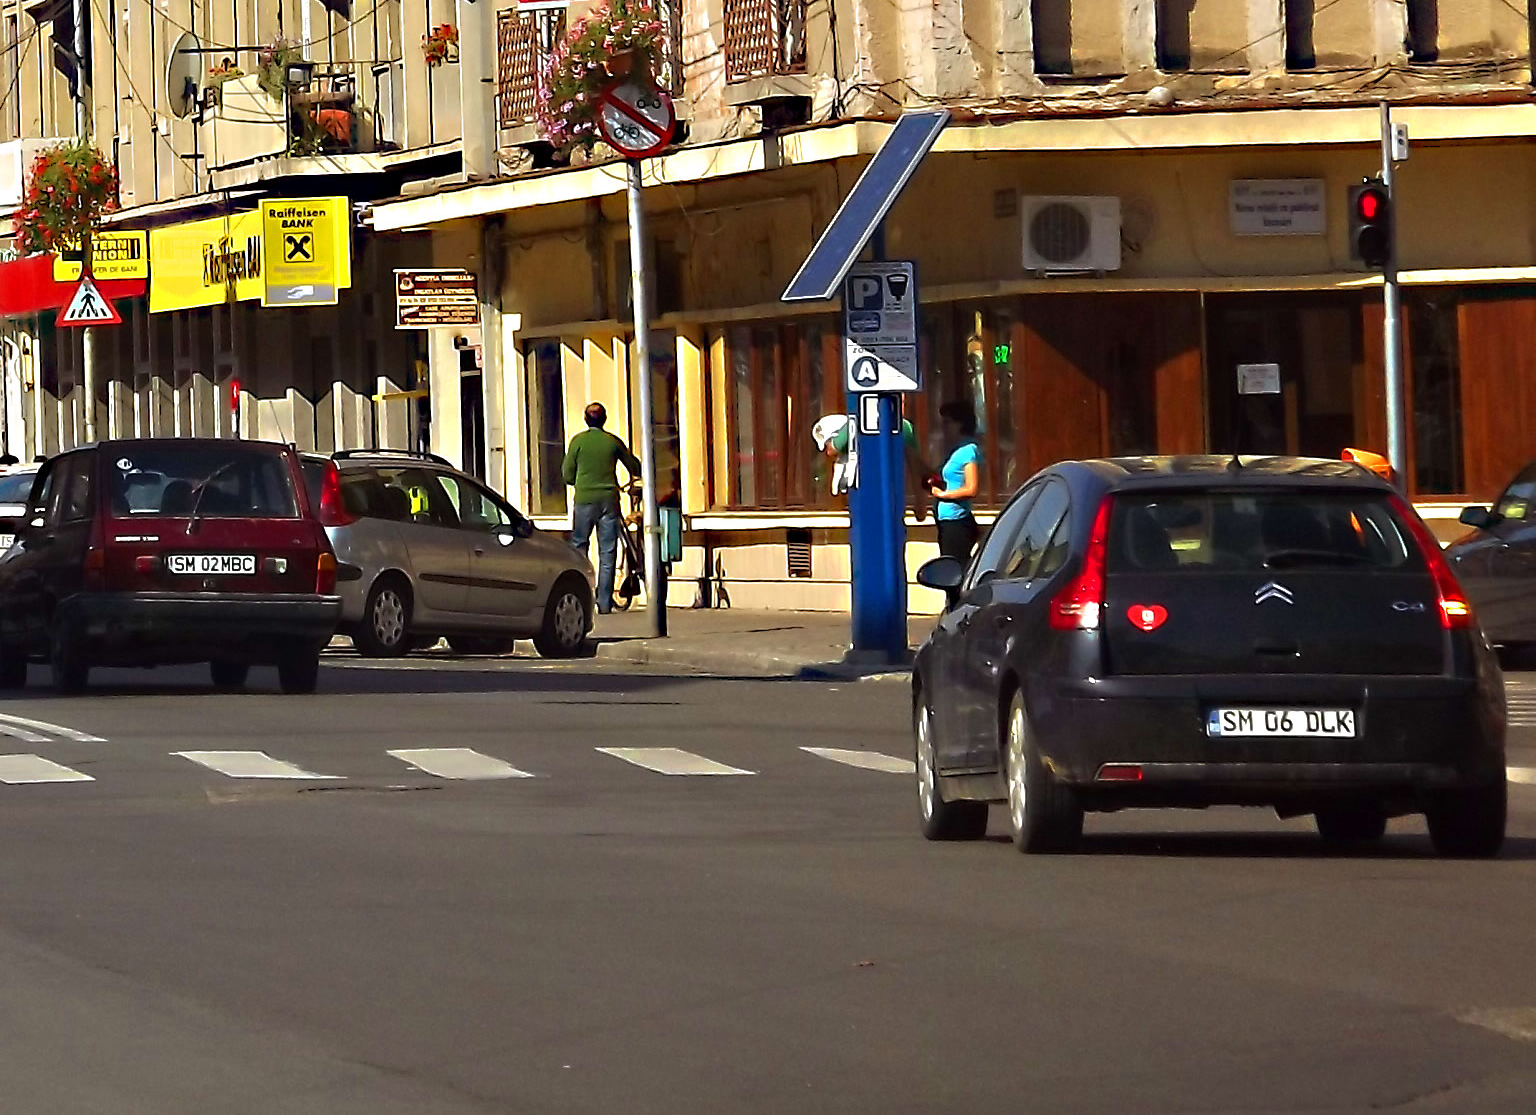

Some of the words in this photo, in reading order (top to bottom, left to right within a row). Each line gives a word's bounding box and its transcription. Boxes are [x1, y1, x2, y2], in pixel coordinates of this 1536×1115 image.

[269, 207, 326, 218] Raiffeisen
[282, 219, 314, 228] BANK
[853, 277, 879, 308] P
[857, 360, 877, 381] A
[175, 557, 195, 571] SM
[1224, 710, 1254, 732] SM
[1265, 710, 1293, 732] 06
[1306, 710, 1351, 733] DLK
